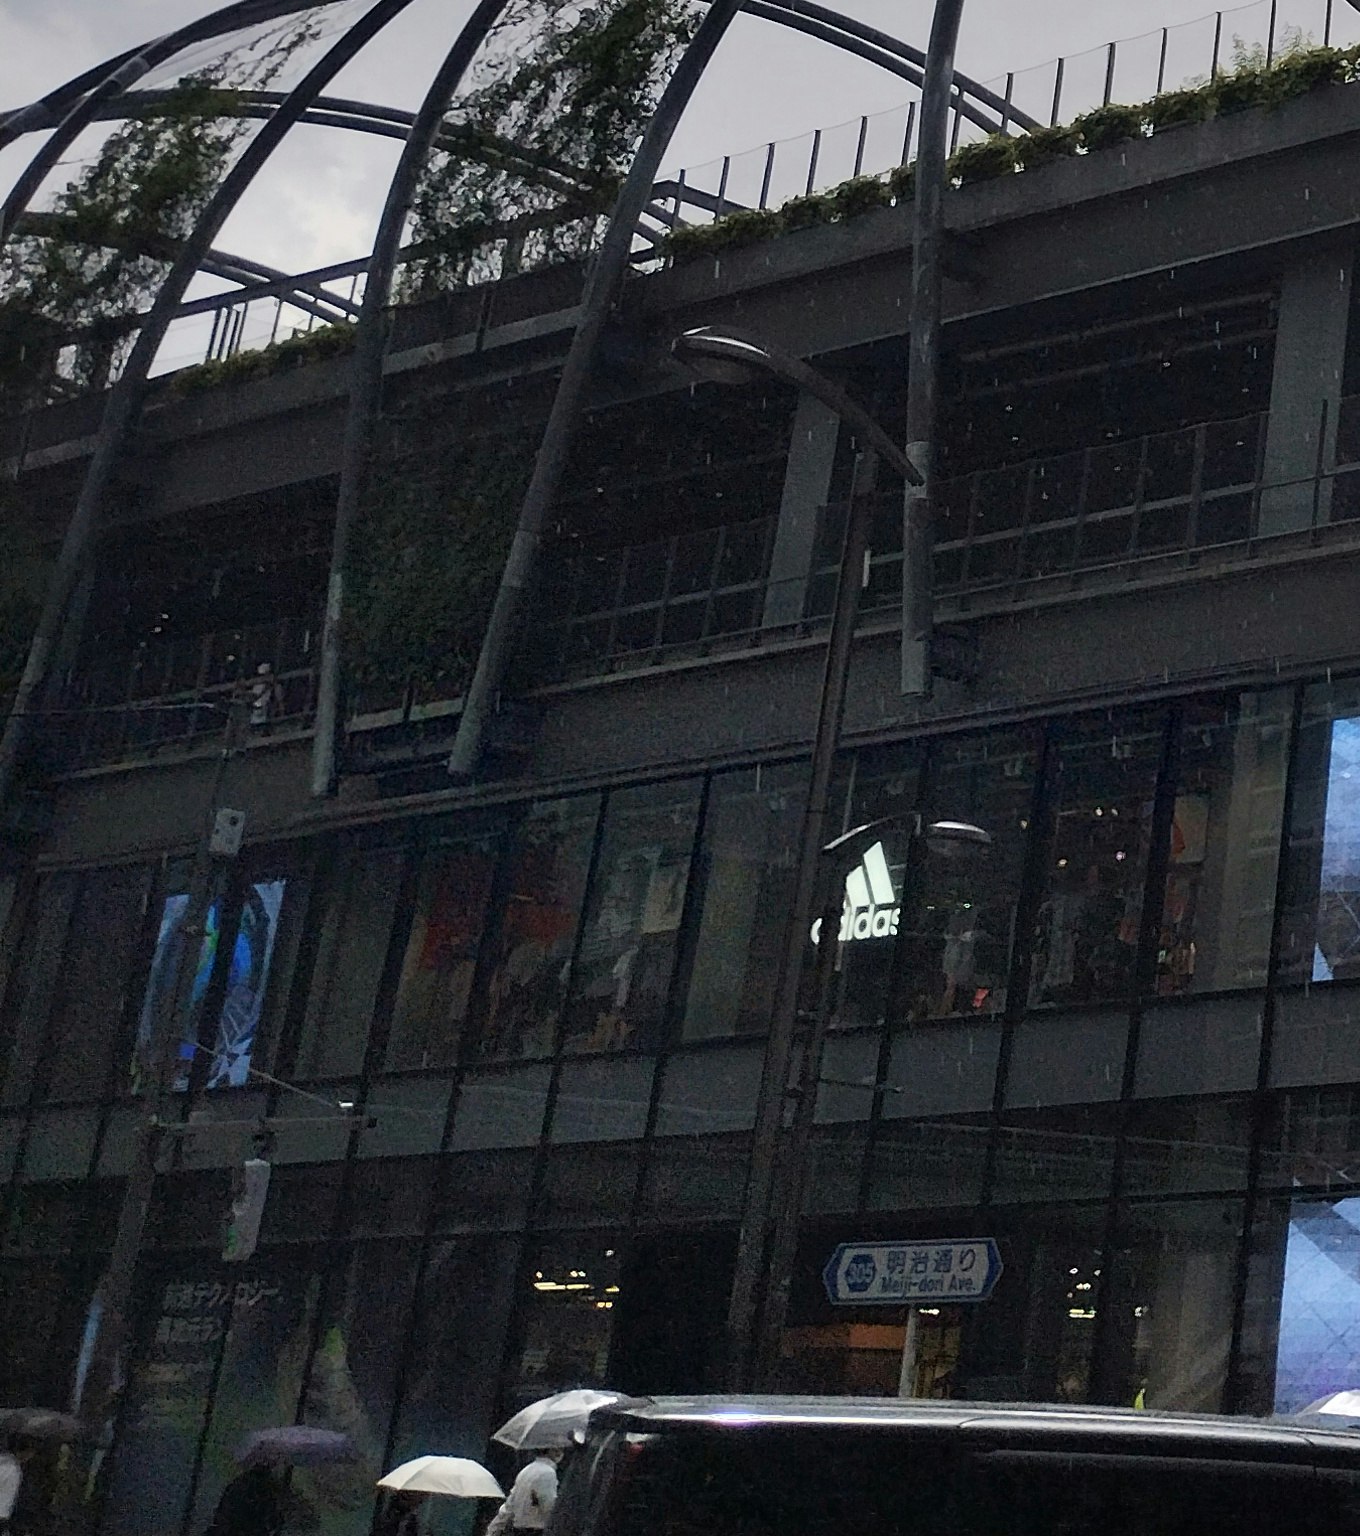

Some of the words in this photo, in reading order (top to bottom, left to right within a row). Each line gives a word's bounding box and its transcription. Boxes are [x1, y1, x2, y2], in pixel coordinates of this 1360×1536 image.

[887, 1248, 977, 1275] 明治通り
[881, 1274, 945, 1295] Meiji-dori
[949, 1275, 976, 1292] Ave.
